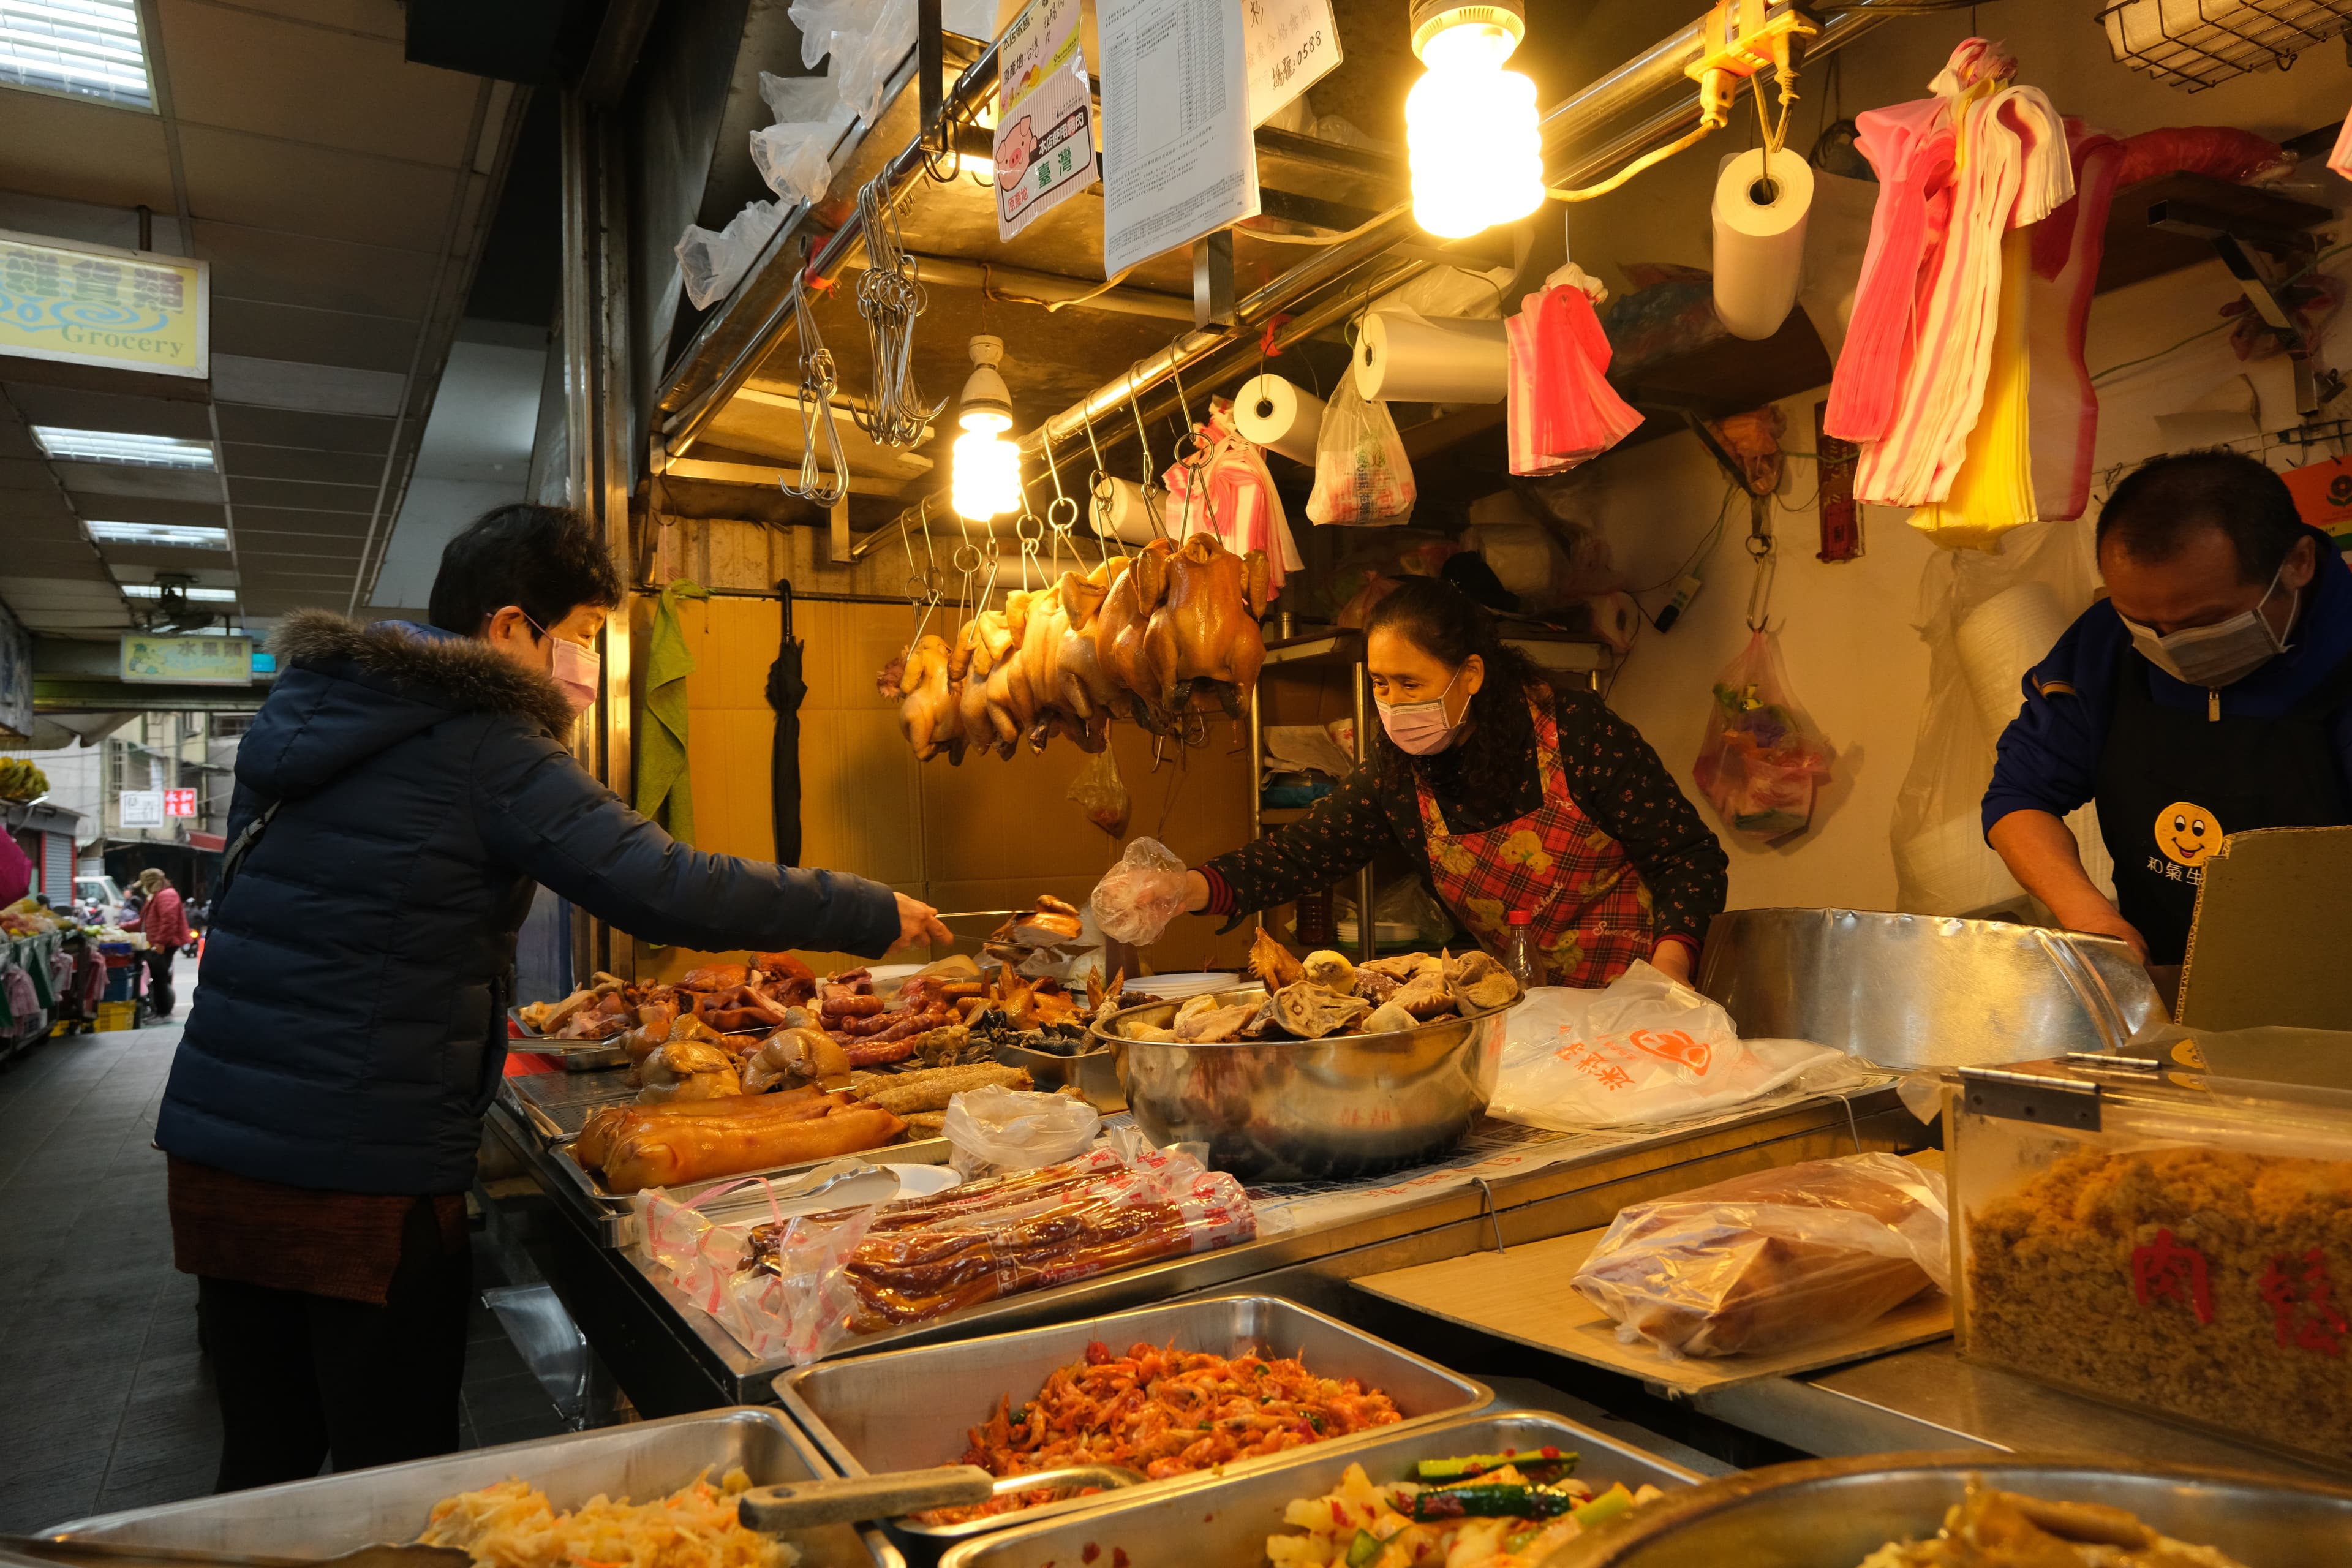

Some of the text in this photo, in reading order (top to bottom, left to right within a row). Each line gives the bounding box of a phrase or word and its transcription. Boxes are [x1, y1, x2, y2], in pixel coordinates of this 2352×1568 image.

[1038, 111, 1084, 156] 本店使用豬肉
[1038, 146, 1072, 189] 臺灣
[1008, 186, 1028, 213] 原產地
[61, 323, 186, 358] Grocery
[2147, 856, 2203, 886] 和氣生
